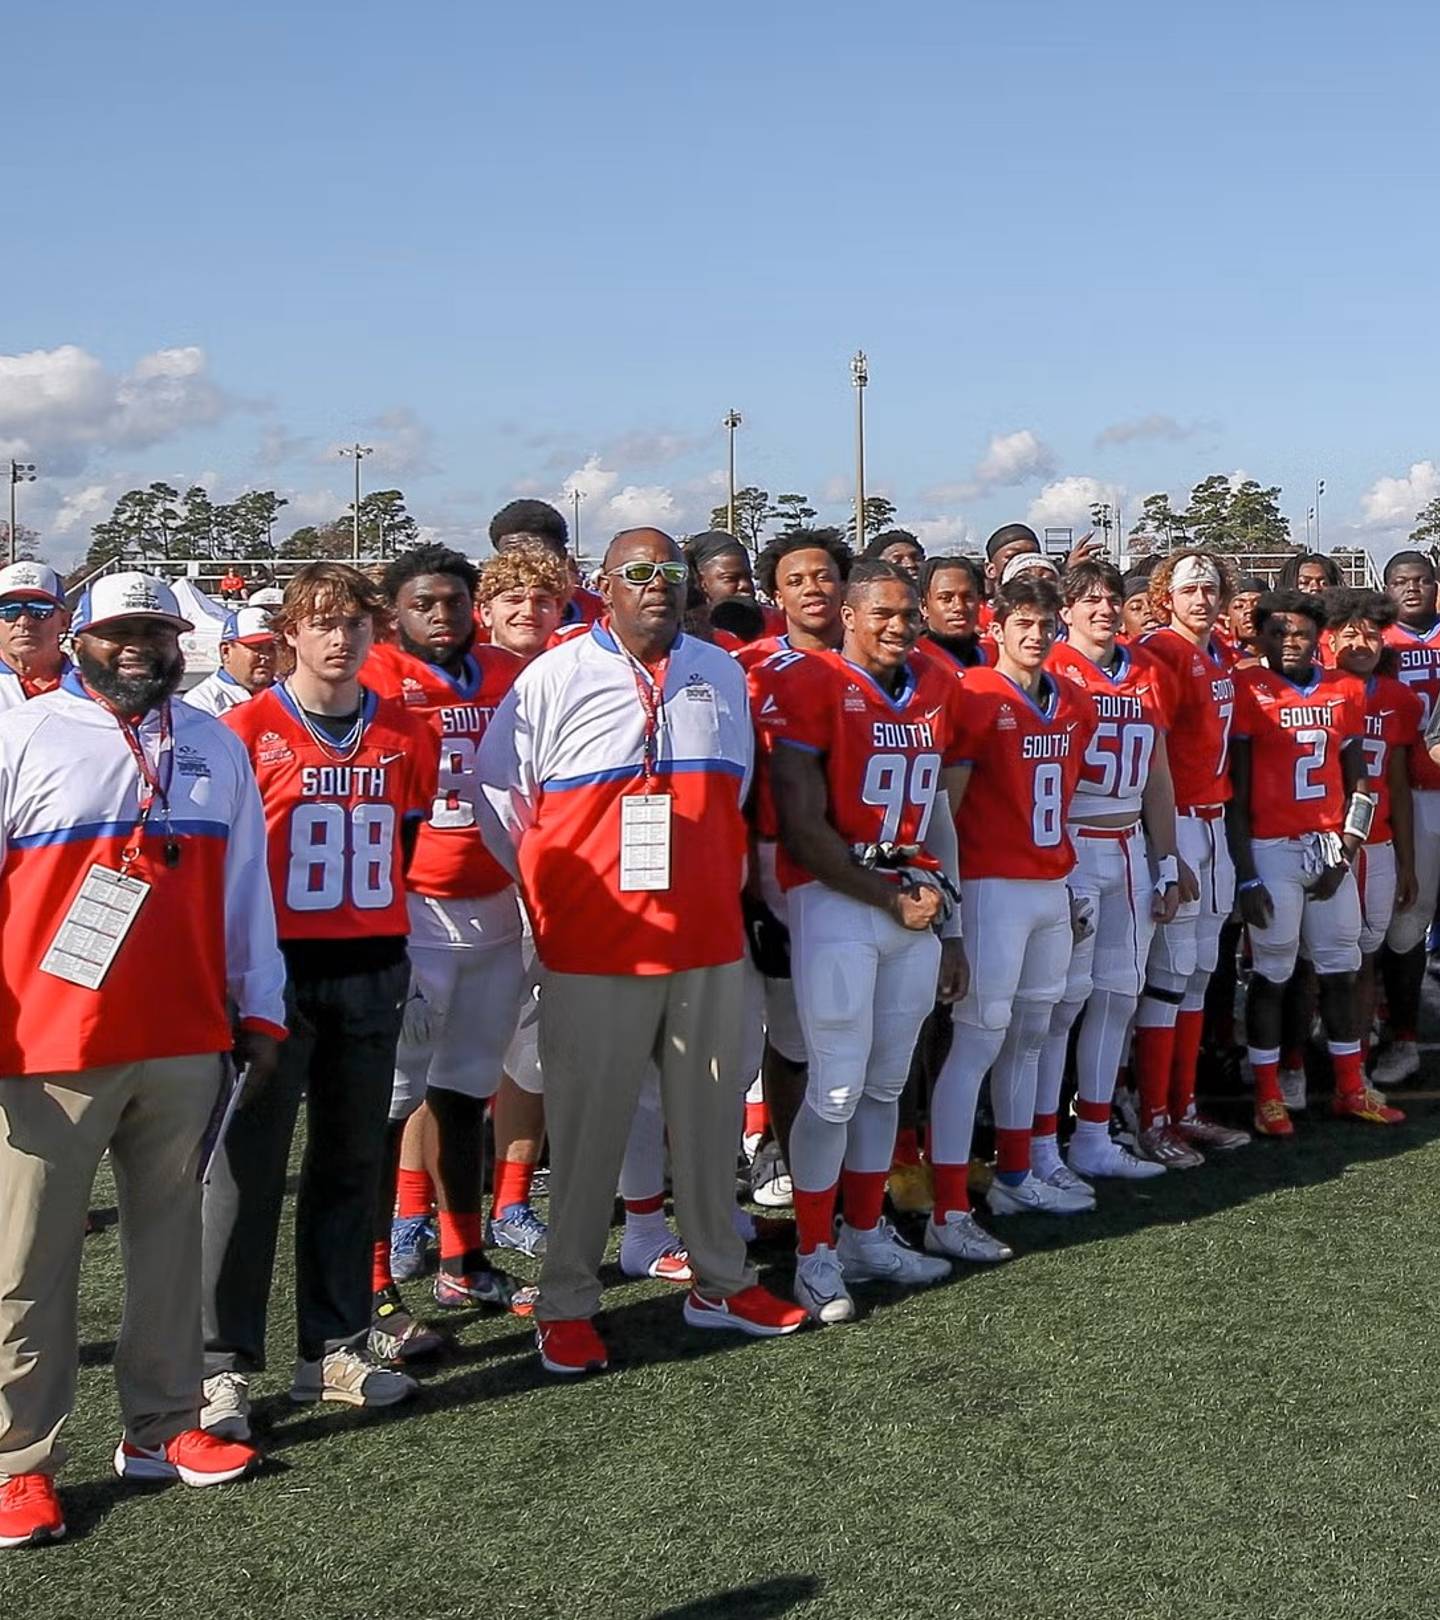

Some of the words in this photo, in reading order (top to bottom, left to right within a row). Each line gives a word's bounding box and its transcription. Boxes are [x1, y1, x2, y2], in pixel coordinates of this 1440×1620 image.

[1211, 678, 1235, 701] SOUTH
[440, 707, 498, 733] SOUT
[873, 722, 933, 748] SOUTH
[1216, 703, 1233, 776] 7
[1280, 706, 1333, 729] SOUTH
[1023, 734, 1069, 759] SOUTH
[1076, 722, 1154, 798] 50
[1296, 730, 1328, 800] 2
[302, 766, 385, 796] SOUTH
[862, 754, 941, 843] 99
[1033, 763, 1063, 847] 8
[286, 803, 396, 911] 88
